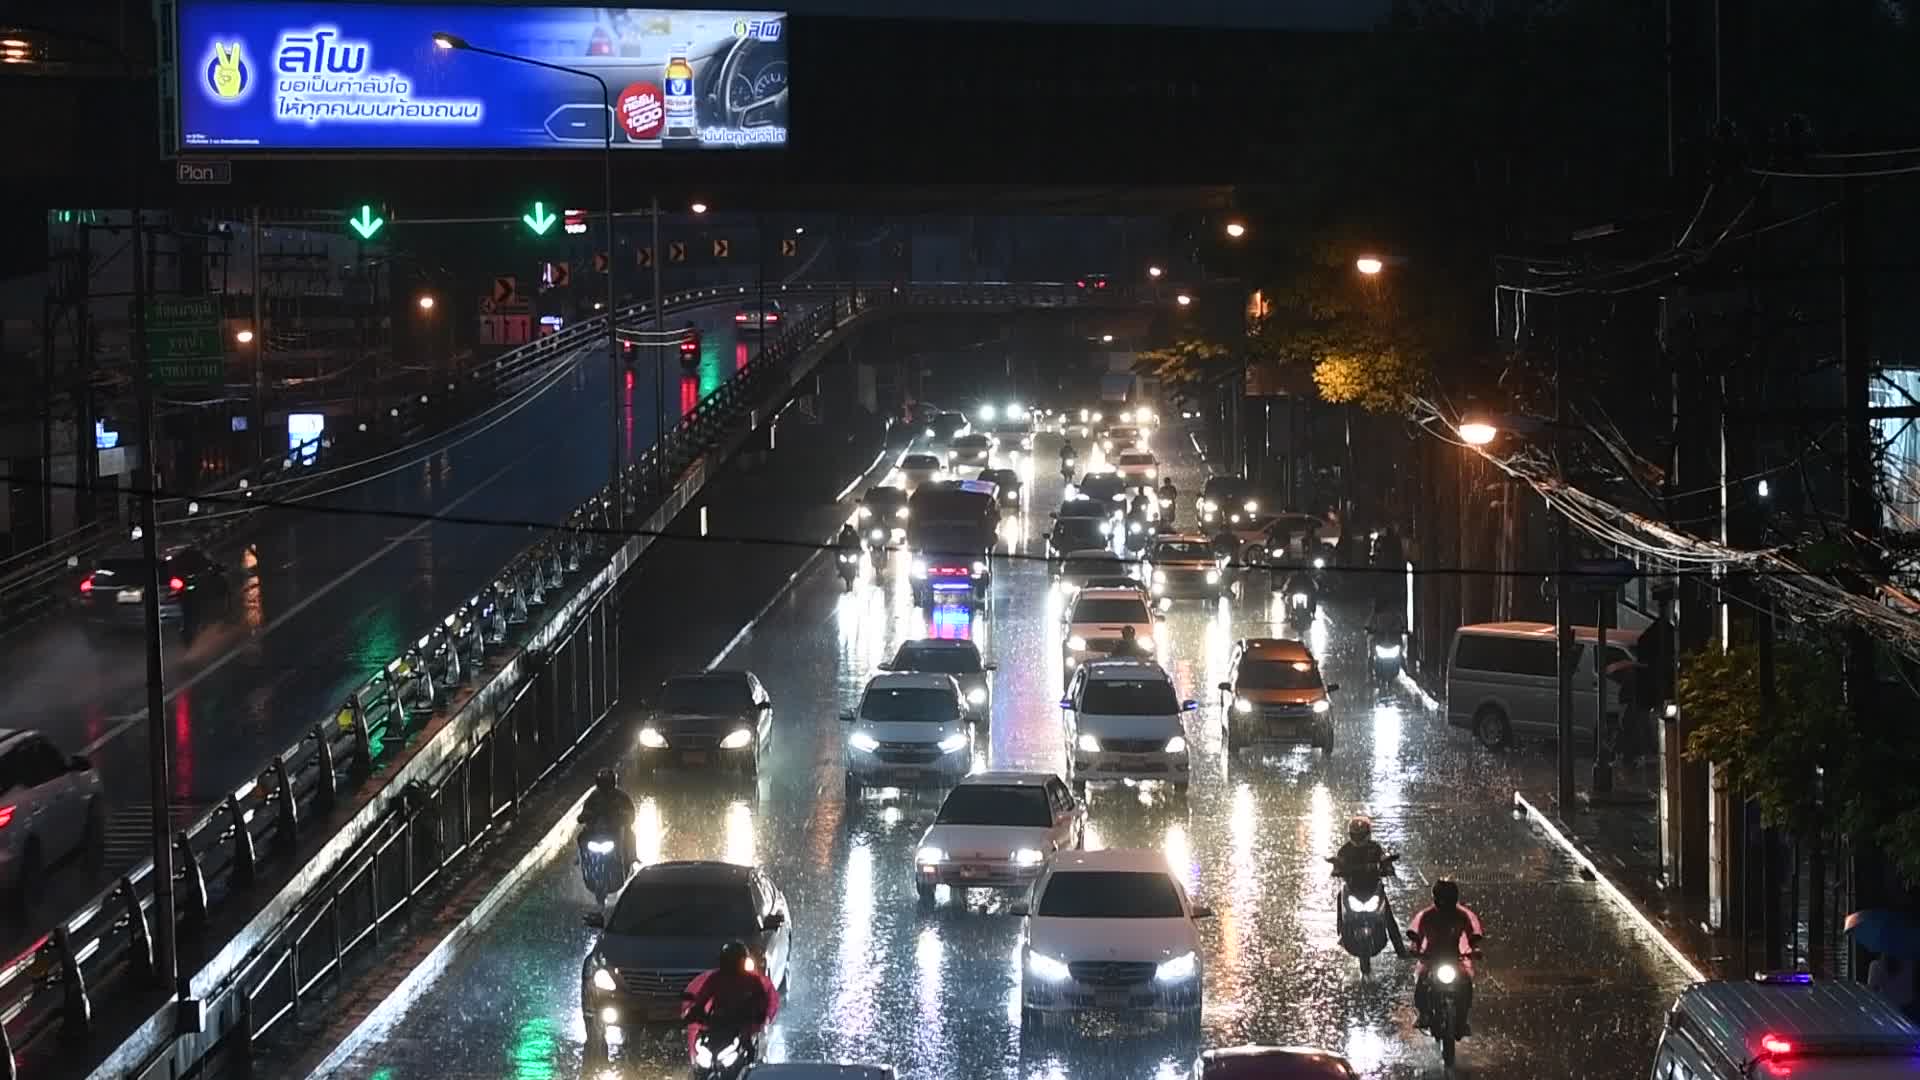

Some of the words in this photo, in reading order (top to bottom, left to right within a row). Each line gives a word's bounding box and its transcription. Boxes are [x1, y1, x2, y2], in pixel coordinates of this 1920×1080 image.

[749, 21, 780, 37] ลิโพ
[279, 32, 365, 73] ลิโพ
[279, 76, 408, 94] ขอเป็นกำลังใจ
[279, 97, 479, 120] ให้ทุกคนบนท้องถนน
[626, 107, 663, 129] 1000
[180, 164, 214, 180] Plan
